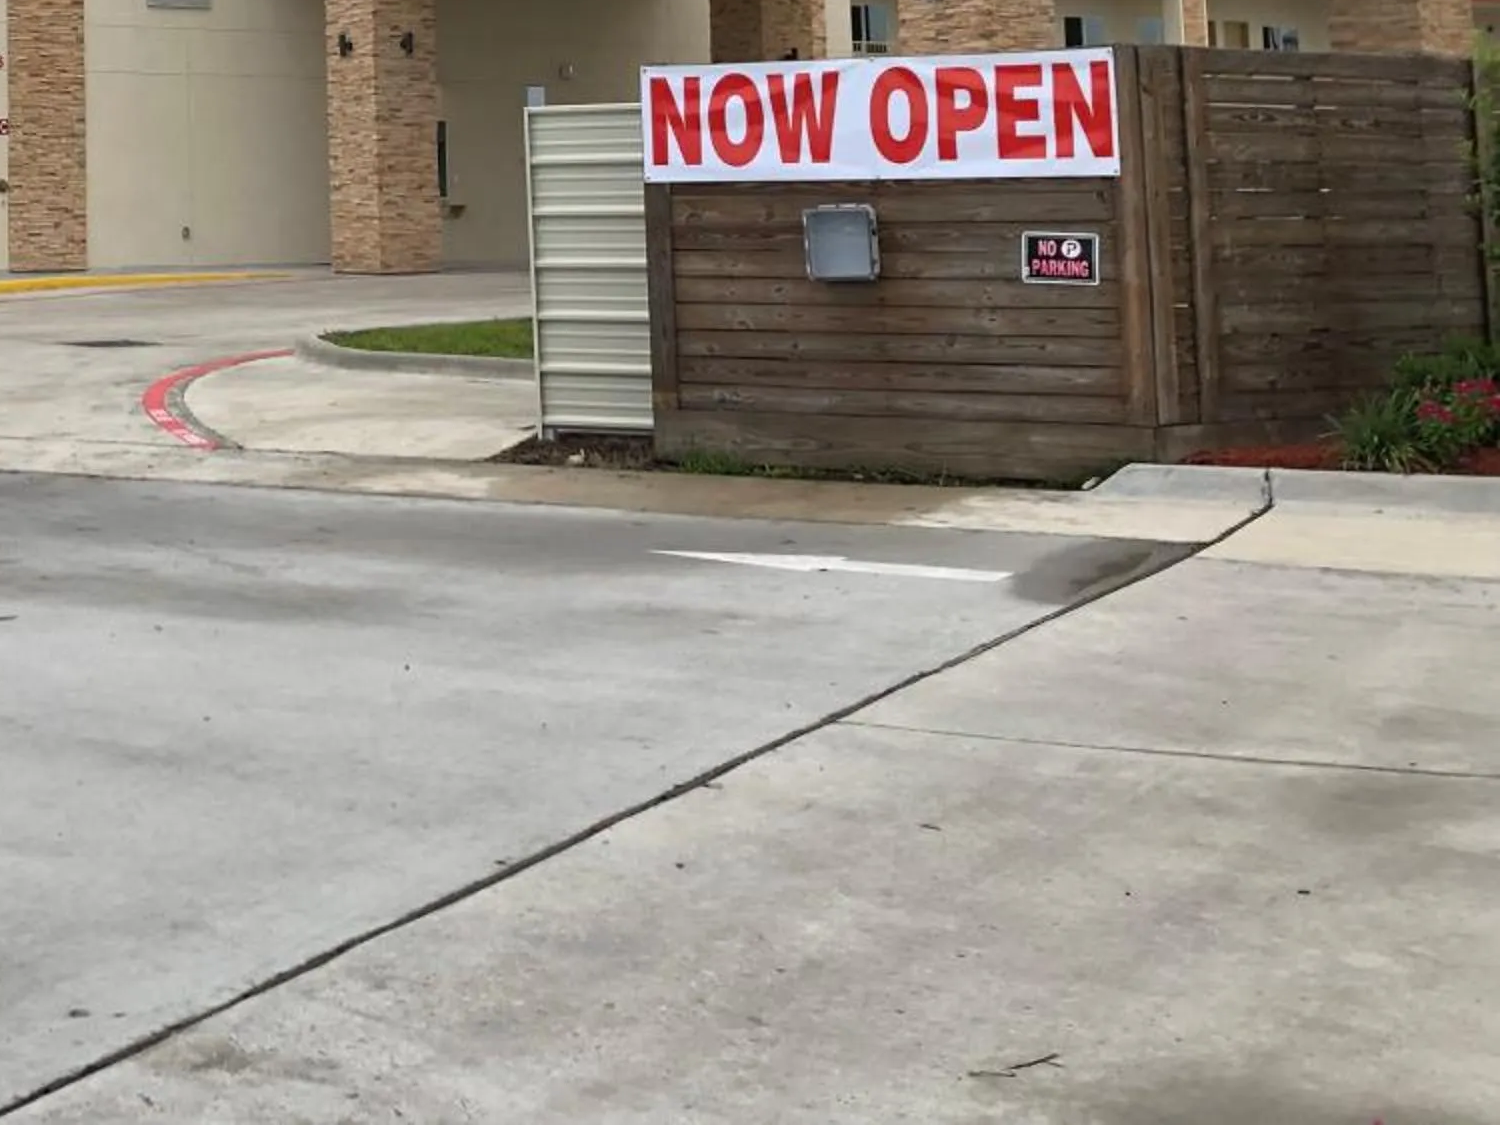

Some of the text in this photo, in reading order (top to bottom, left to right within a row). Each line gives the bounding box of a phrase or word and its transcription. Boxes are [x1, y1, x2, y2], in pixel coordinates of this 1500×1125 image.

[650, 60, 1114, 168] NOW OPEN
[1037, 239, 1057, 257] NO
[1031, 258, 1090, 277] PARKING
